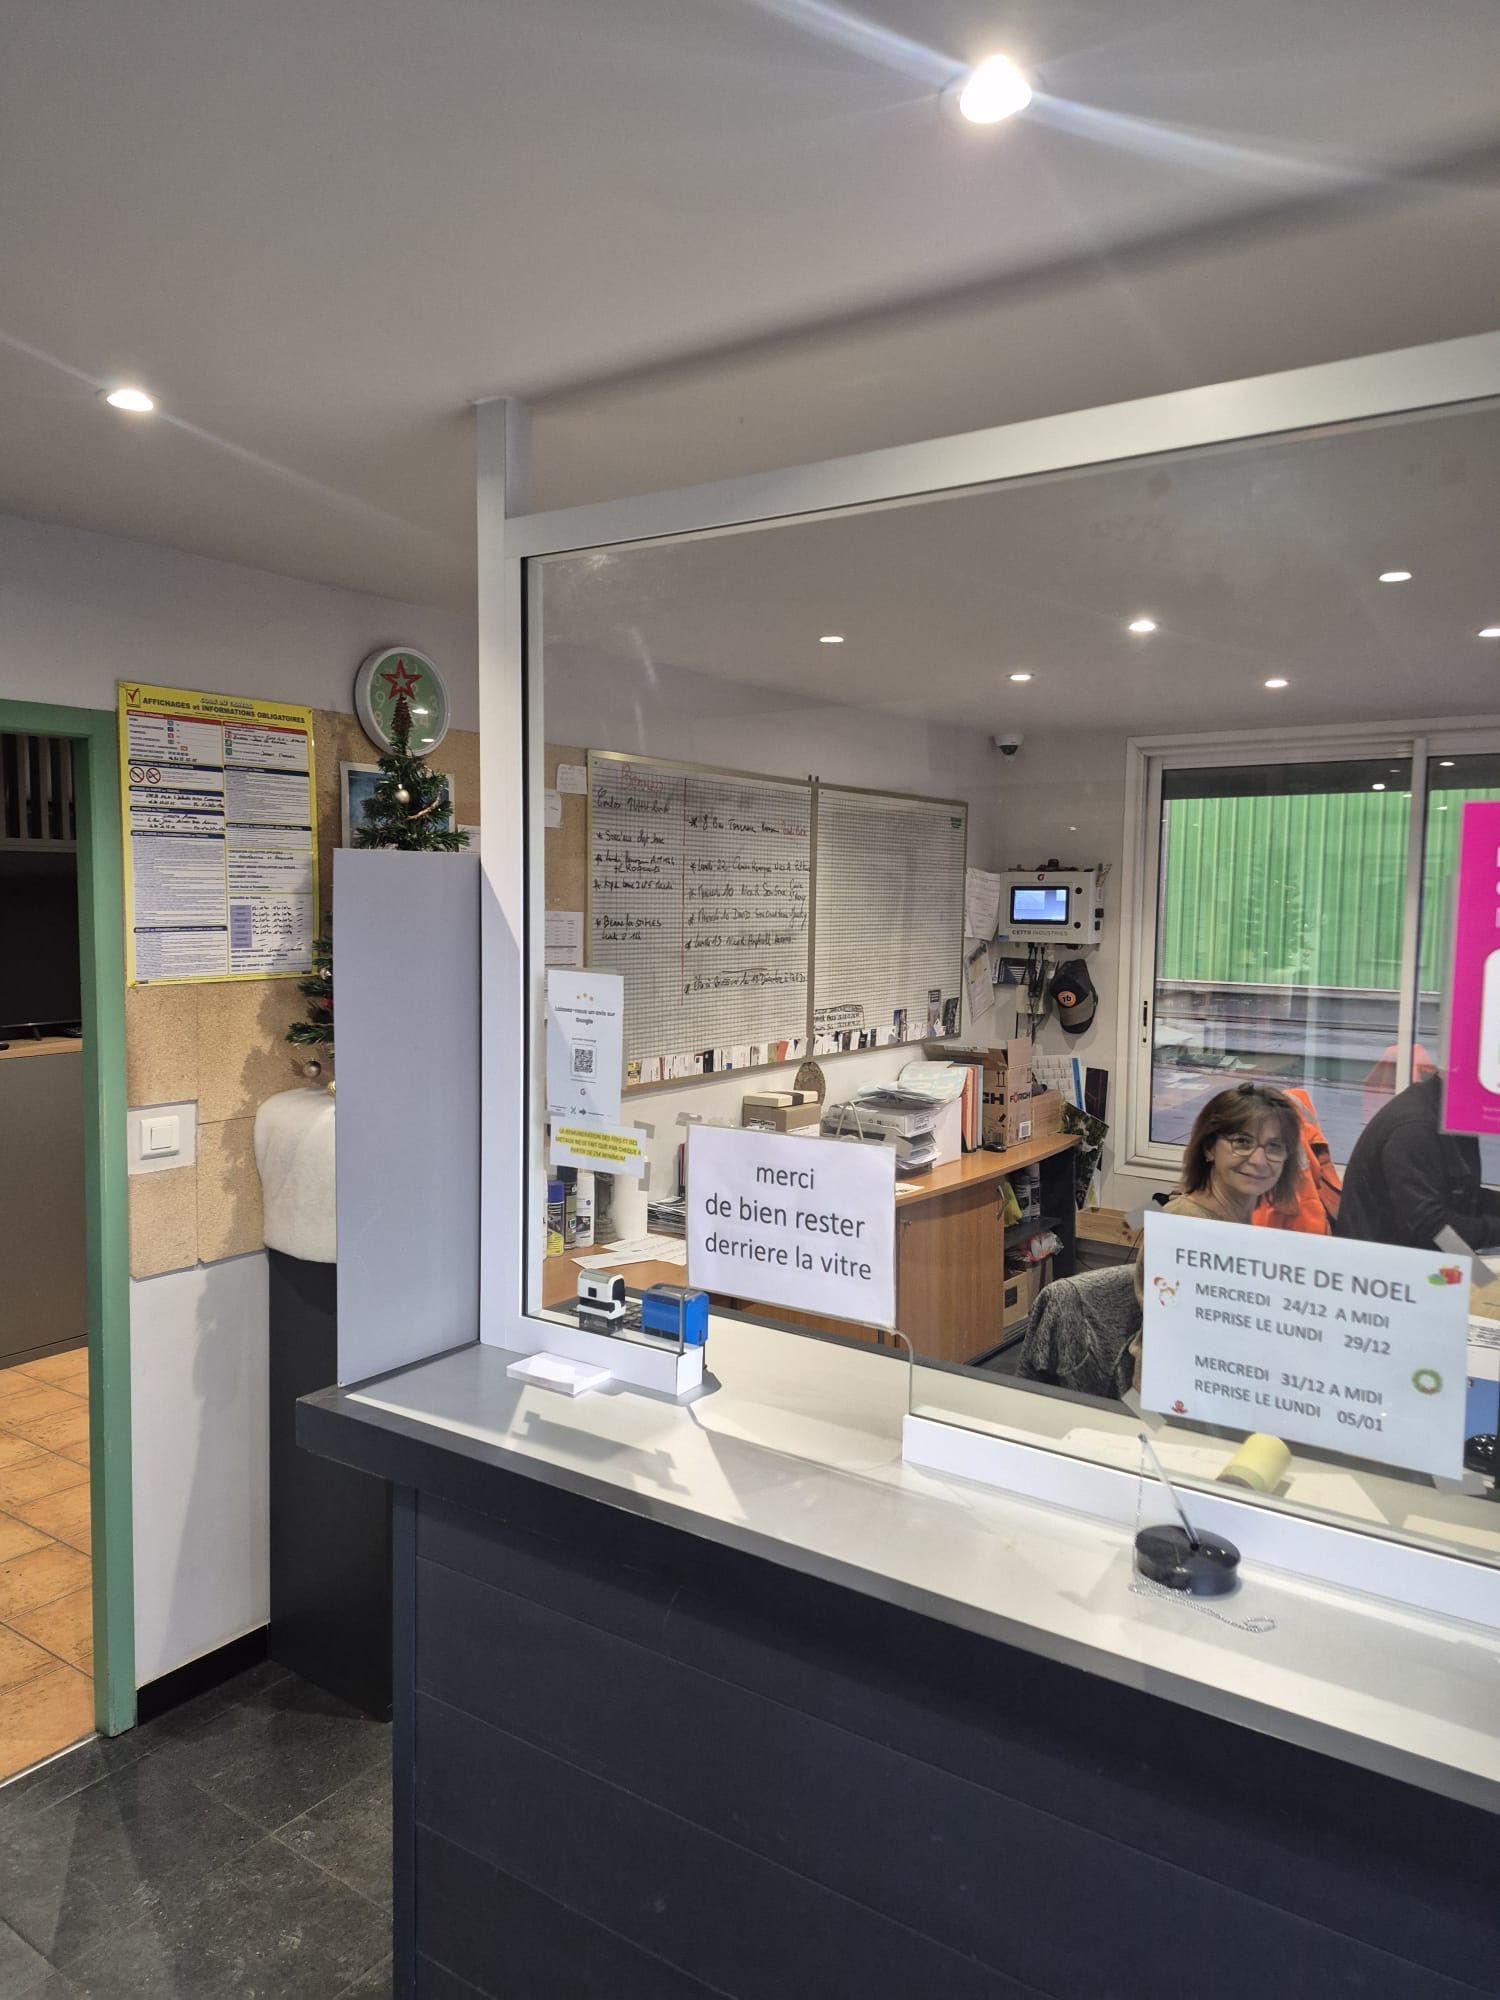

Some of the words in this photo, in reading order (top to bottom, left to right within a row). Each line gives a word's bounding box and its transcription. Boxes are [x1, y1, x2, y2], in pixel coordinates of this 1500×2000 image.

[142, 697, 191, 710] AFFICHAGES
[192, 704, 201, 712] et
[202, 704, 256, 718] INFORMATIONS
[257, 712, 305, 724] OBLIGATOIRES
[575, 1017, 594, 1026] Google
[756, 1166, 815, 1190] merci
[705, 1192, 732, 1218] de
[739, 1196, 787, 1227] bien
[795, 1210, 866, 1239] rester
[705, 1231, 788, 1266] derriere
[796, 1246, 813, 1270] la
[820, 1253, 872, 1280] vitre
[1175, 1248, 1306, 1285] FERMETURE
[1313, 1269, 1344, 1292] DE
[1351, 1275, 1417, 1304] NOEL
[1195, 1282, 1271, 1307] MERCREDI
[1282, 1297, 1328, 1318] 24/12
[1335, 1307, 1348, 1322] A
[1351, 1309, 1390, 1329] MIDI
[1195, 1306, 1252, 1329] REPRISE
[1256, 1317, 1272, 1333] LE
[1276, 1322, 1323, 1343] LUNDI
[1343, 1334, 1392, 1356] 29/12
[1194, 1354, 1270, 1382] MERCREDI
[1280, 1372, 1326, 1395] 31/12
[1328, 1383, 1341, 1397] A
[1344, 1387, 1383, 1406] MIDI
[1194, 1378, 1251, 1403] REPRISE
[1254, 1390, 1271, 1407] LE
[1275, 1395, 1321, 1419] LUNDI
[1336, 1409, 1384, 1432] 05/01
